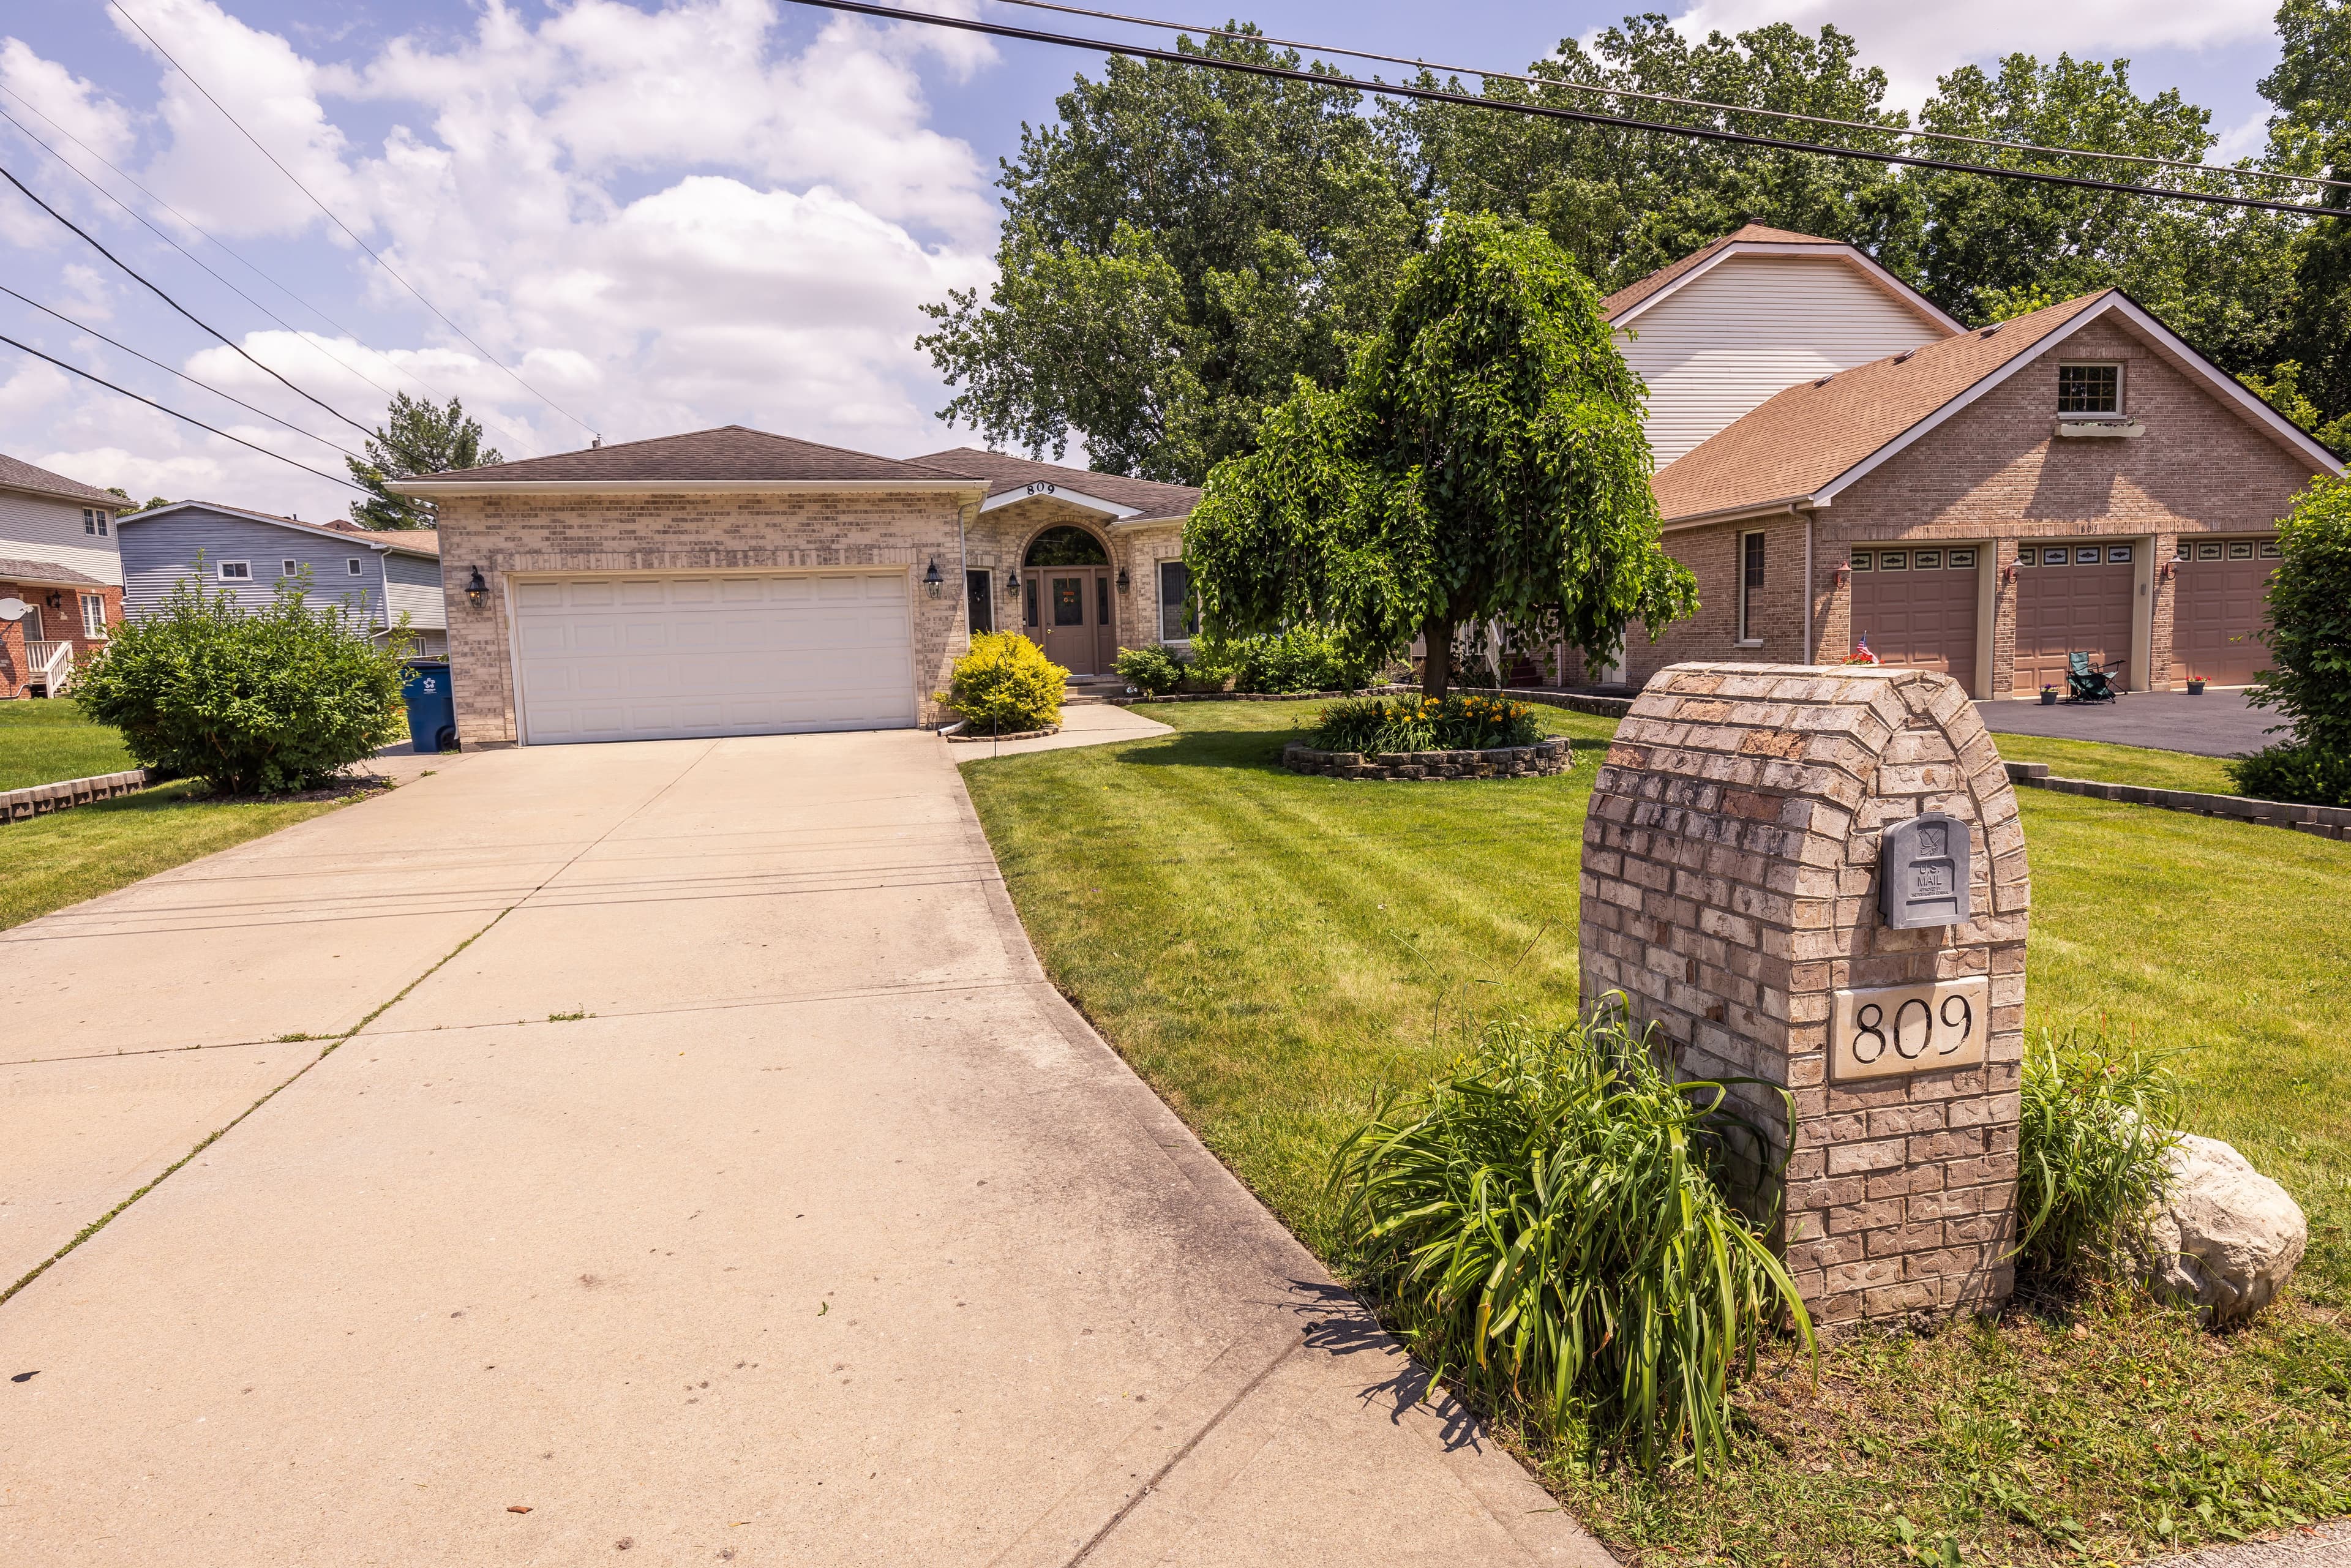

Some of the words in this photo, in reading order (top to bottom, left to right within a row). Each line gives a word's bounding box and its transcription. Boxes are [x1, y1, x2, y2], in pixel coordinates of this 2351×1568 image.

[1027, 482, 1055, 495] 809
[1918, 875, 1942, 887] MAIL
[1853, 994, 1972, 1064] 809
